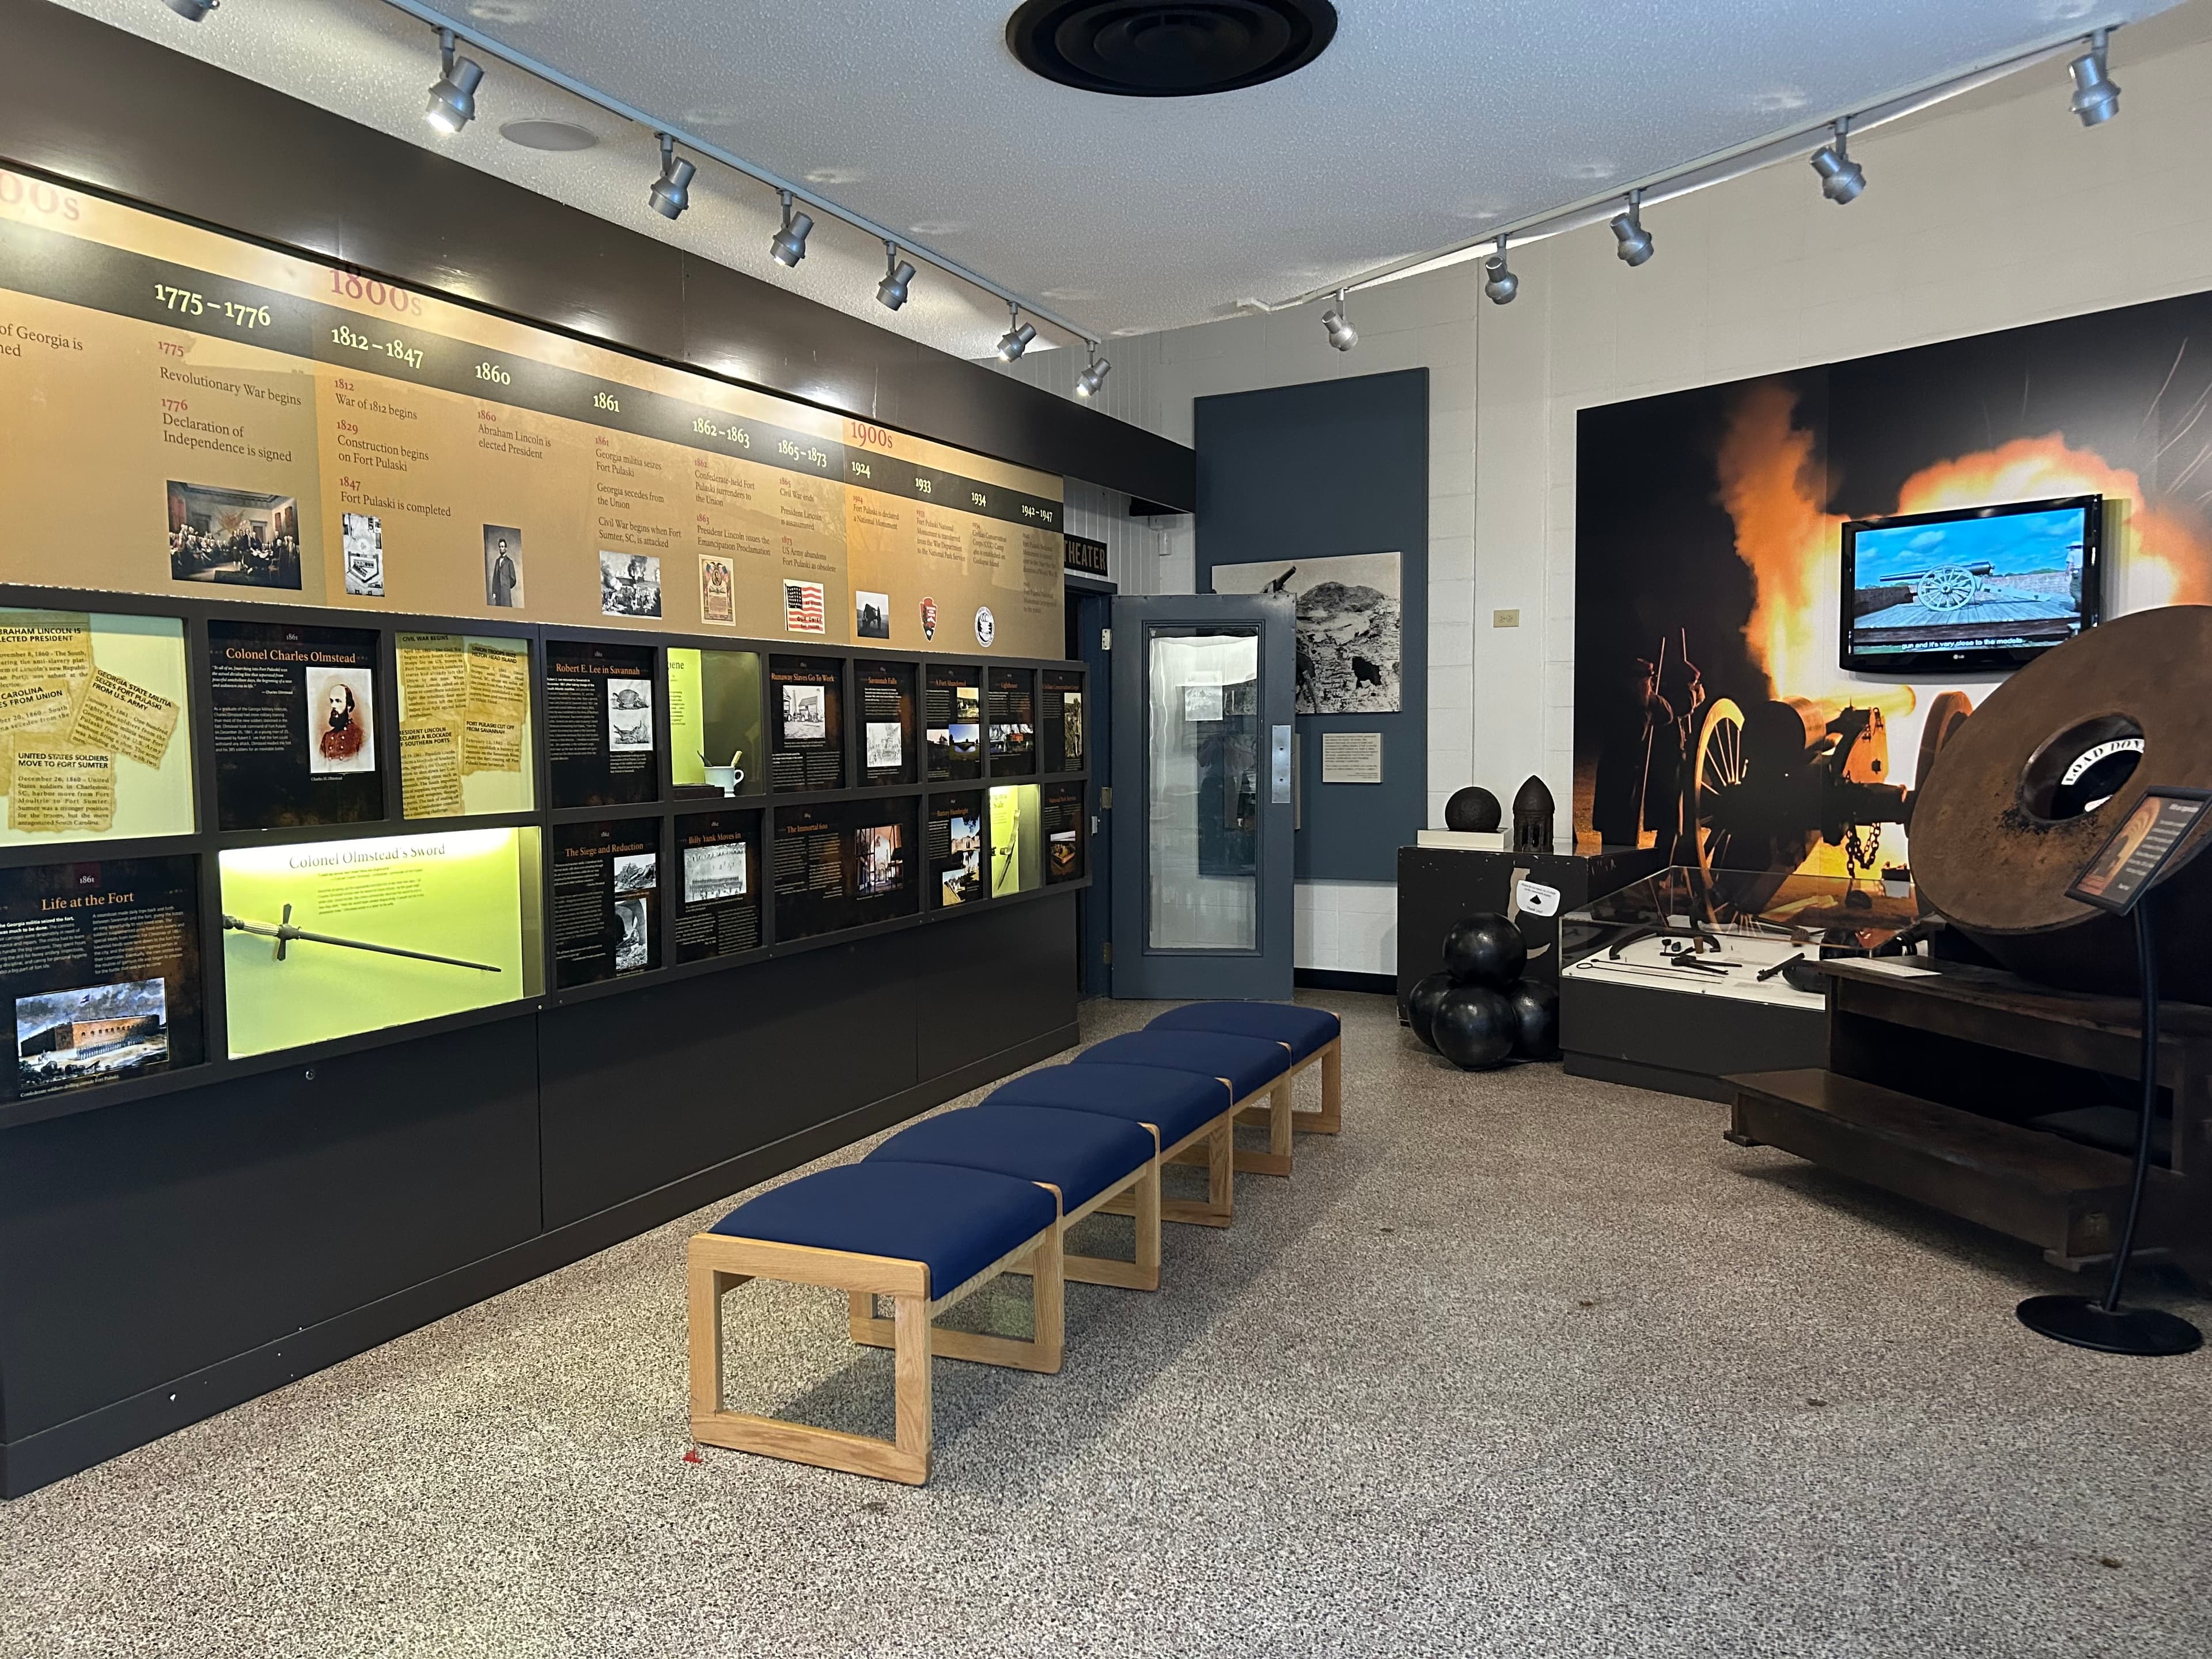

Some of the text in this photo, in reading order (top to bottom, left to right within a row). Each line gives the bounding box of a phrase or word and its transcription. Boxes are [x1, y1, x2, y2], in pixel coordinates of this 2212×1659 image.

[329, 266, 422, 316] 1800s
[0, 324, 83, 350] of Georgia is
[158, 342, 184, 357] 1775
[475, 362, 511, 385] 1860
[160, 367, 301, 406] Revolutionary War begins
[335, 379, 354, 391] 1812
[161, 398, 188, 412] 1776
[335, 393, 417, 419] War of 1812 begins
[593, 392, 620, 412] 1861
[162, 412, 244, 437] Declaration of
[478, 410, 496, 422] 1860
[337, 419, 358, 434] 1829
[478, 424, 551, 447] Abraham Lincoln is
[851, 421, 892, 448] 1900s
[164, 430, 291, 461] Independence is signed
[338, 435, 429, 461] Construction begins
[479, 438, 543, 459] elected President
[596, 436, 609, 446] 1861
[339, 452, 407, 471] on Fort Pulaski
[596, 448, 662, 470] Georgia militia seizes
[597, 461, 634, 477] Fort Pulaski
[852, 461, 870, 479] 1924
[339, 476, 361, 491] 1847
[695, 470, 755, 490] Confederate-held Fort
[915, 478, 931, 494] 1933
[597, 483, 664, 503] Georgia secedes from
[696, 482, 715, 493] Pulaski
[716, 488, 745, 499] surrenders
[972, 492, 986, 507] 1934
[341, 491, 450, 516] Fort Pulaski is completed
[598, 496, 630, 509] the Union
[696, 495, 724, 506] the Union
[599, 516, 681, 537] Civil War begins when Fort
[696, 513, 710, 525] 1863
[599, 529, 624, 543] Sumter,
[643, 537, 669, 548] attacked
[697, 525, 722, 537] President
[725, 529, 744, 540] Lincoln
[762, 536, 770, 544] the
[1064, 540, 1105, 570] THEATER
[226, 647, 356, 663] Colonel Charles Olmstead
[556, 664, 579, 673] Robert
[589, 665, 601, 673] Lee
[603, 665, 609, 674] in
[610, 666, 640, 675] Savannah
[1, 687, 43, 699] CAROLINA
[10, 690, 63, 706] FROM UNION
[92, 683, 148, 711] FROM U.S. ARMY
[94, 676, 162, 710] SEIZES FORT PULASKI
[98, 670, 172, 707] GEORGIA STATE MILITIA
[289, 853, 339, 869] Colonel
[410, 843, 445, 857] Sword
[565, 843, 643, 857] The Siege and Reduction
[79, 876, 94, 884] 1861
[41, 892, 134, 911] Life at the Fort
